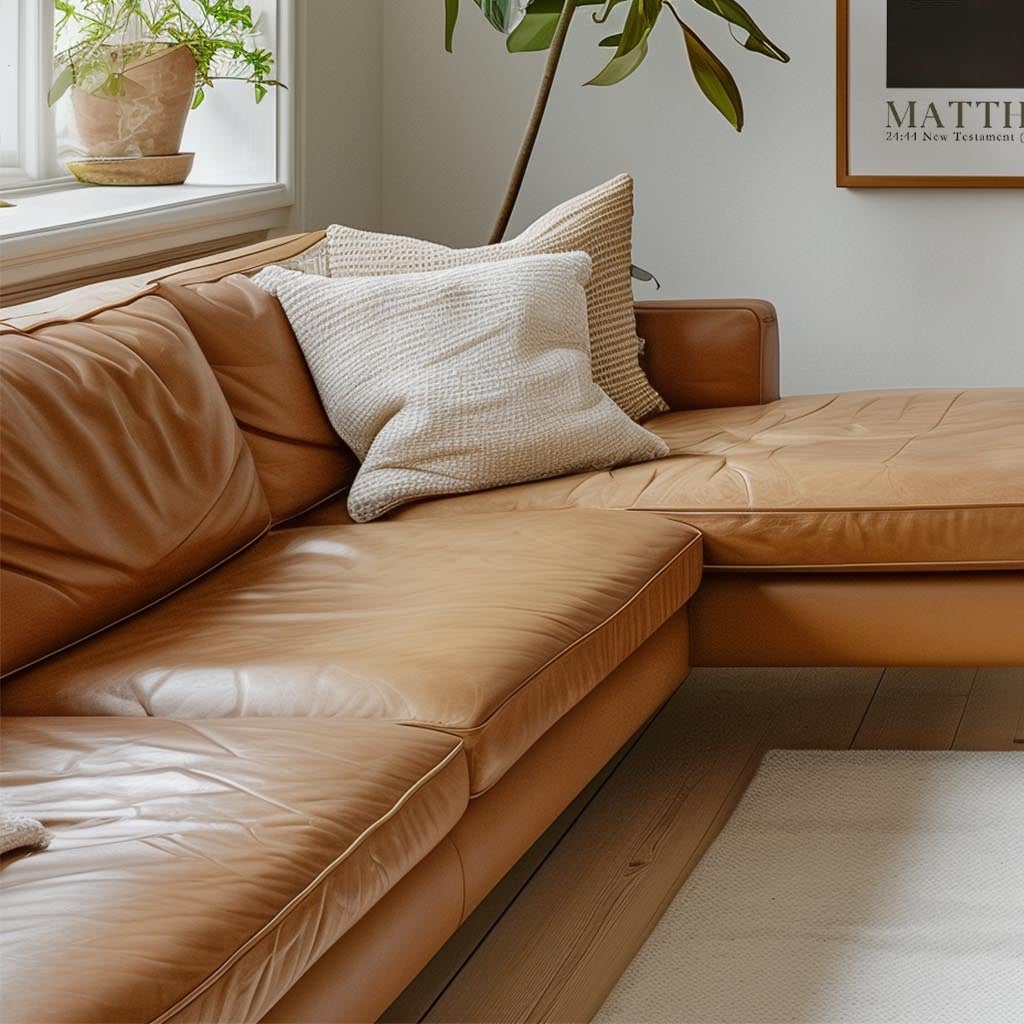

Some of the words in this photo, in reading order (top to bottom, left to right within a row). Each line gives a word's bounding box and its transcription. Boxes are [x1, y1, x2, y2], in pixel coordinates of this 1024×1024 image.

[885, 131, 918, 142] 24:44
[922, 131, 948, 142] New
[952, 131, 1015, 142] Testament
